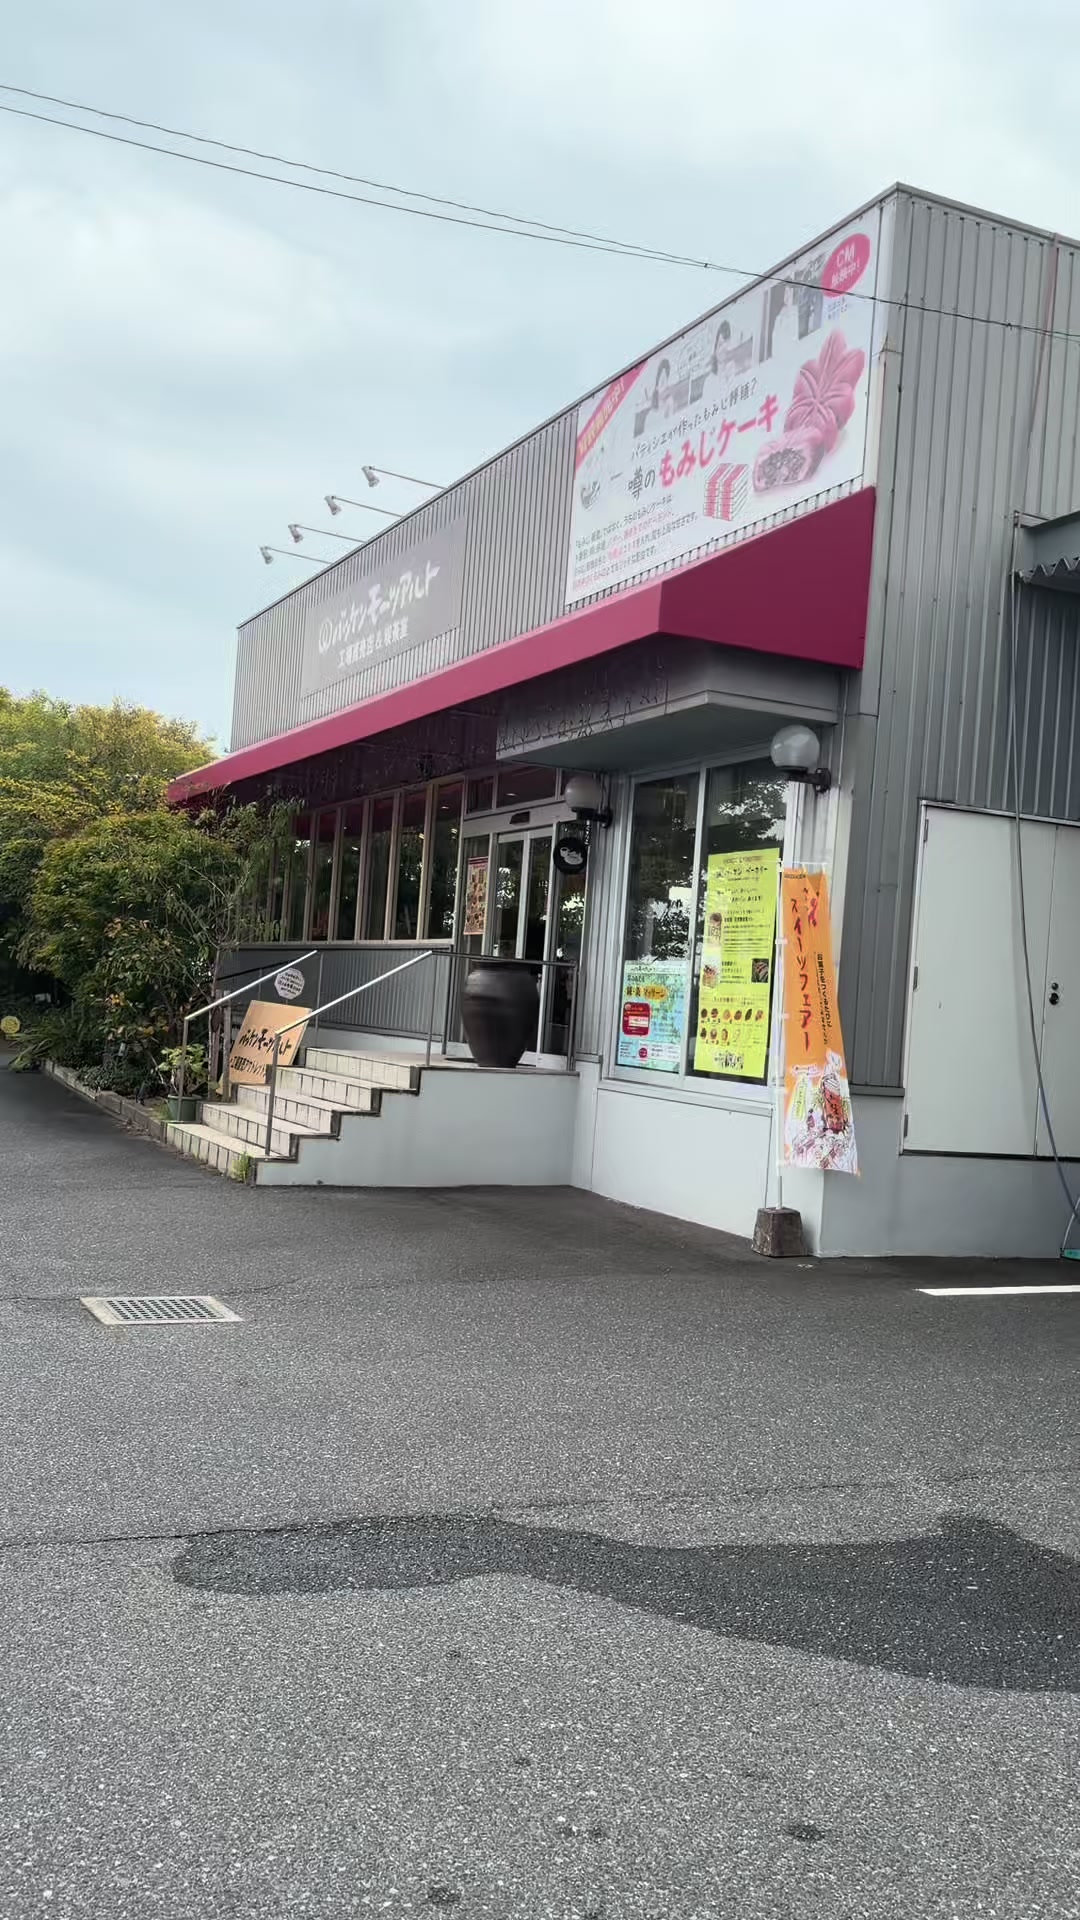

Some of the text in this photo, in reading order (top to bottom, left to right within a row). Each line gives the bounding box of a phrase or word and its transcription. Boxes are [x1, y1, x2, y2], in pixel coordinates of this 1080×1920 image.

[836, 243, 856, 268] CM
[659, 394, 780, 488] もみじケーキ
